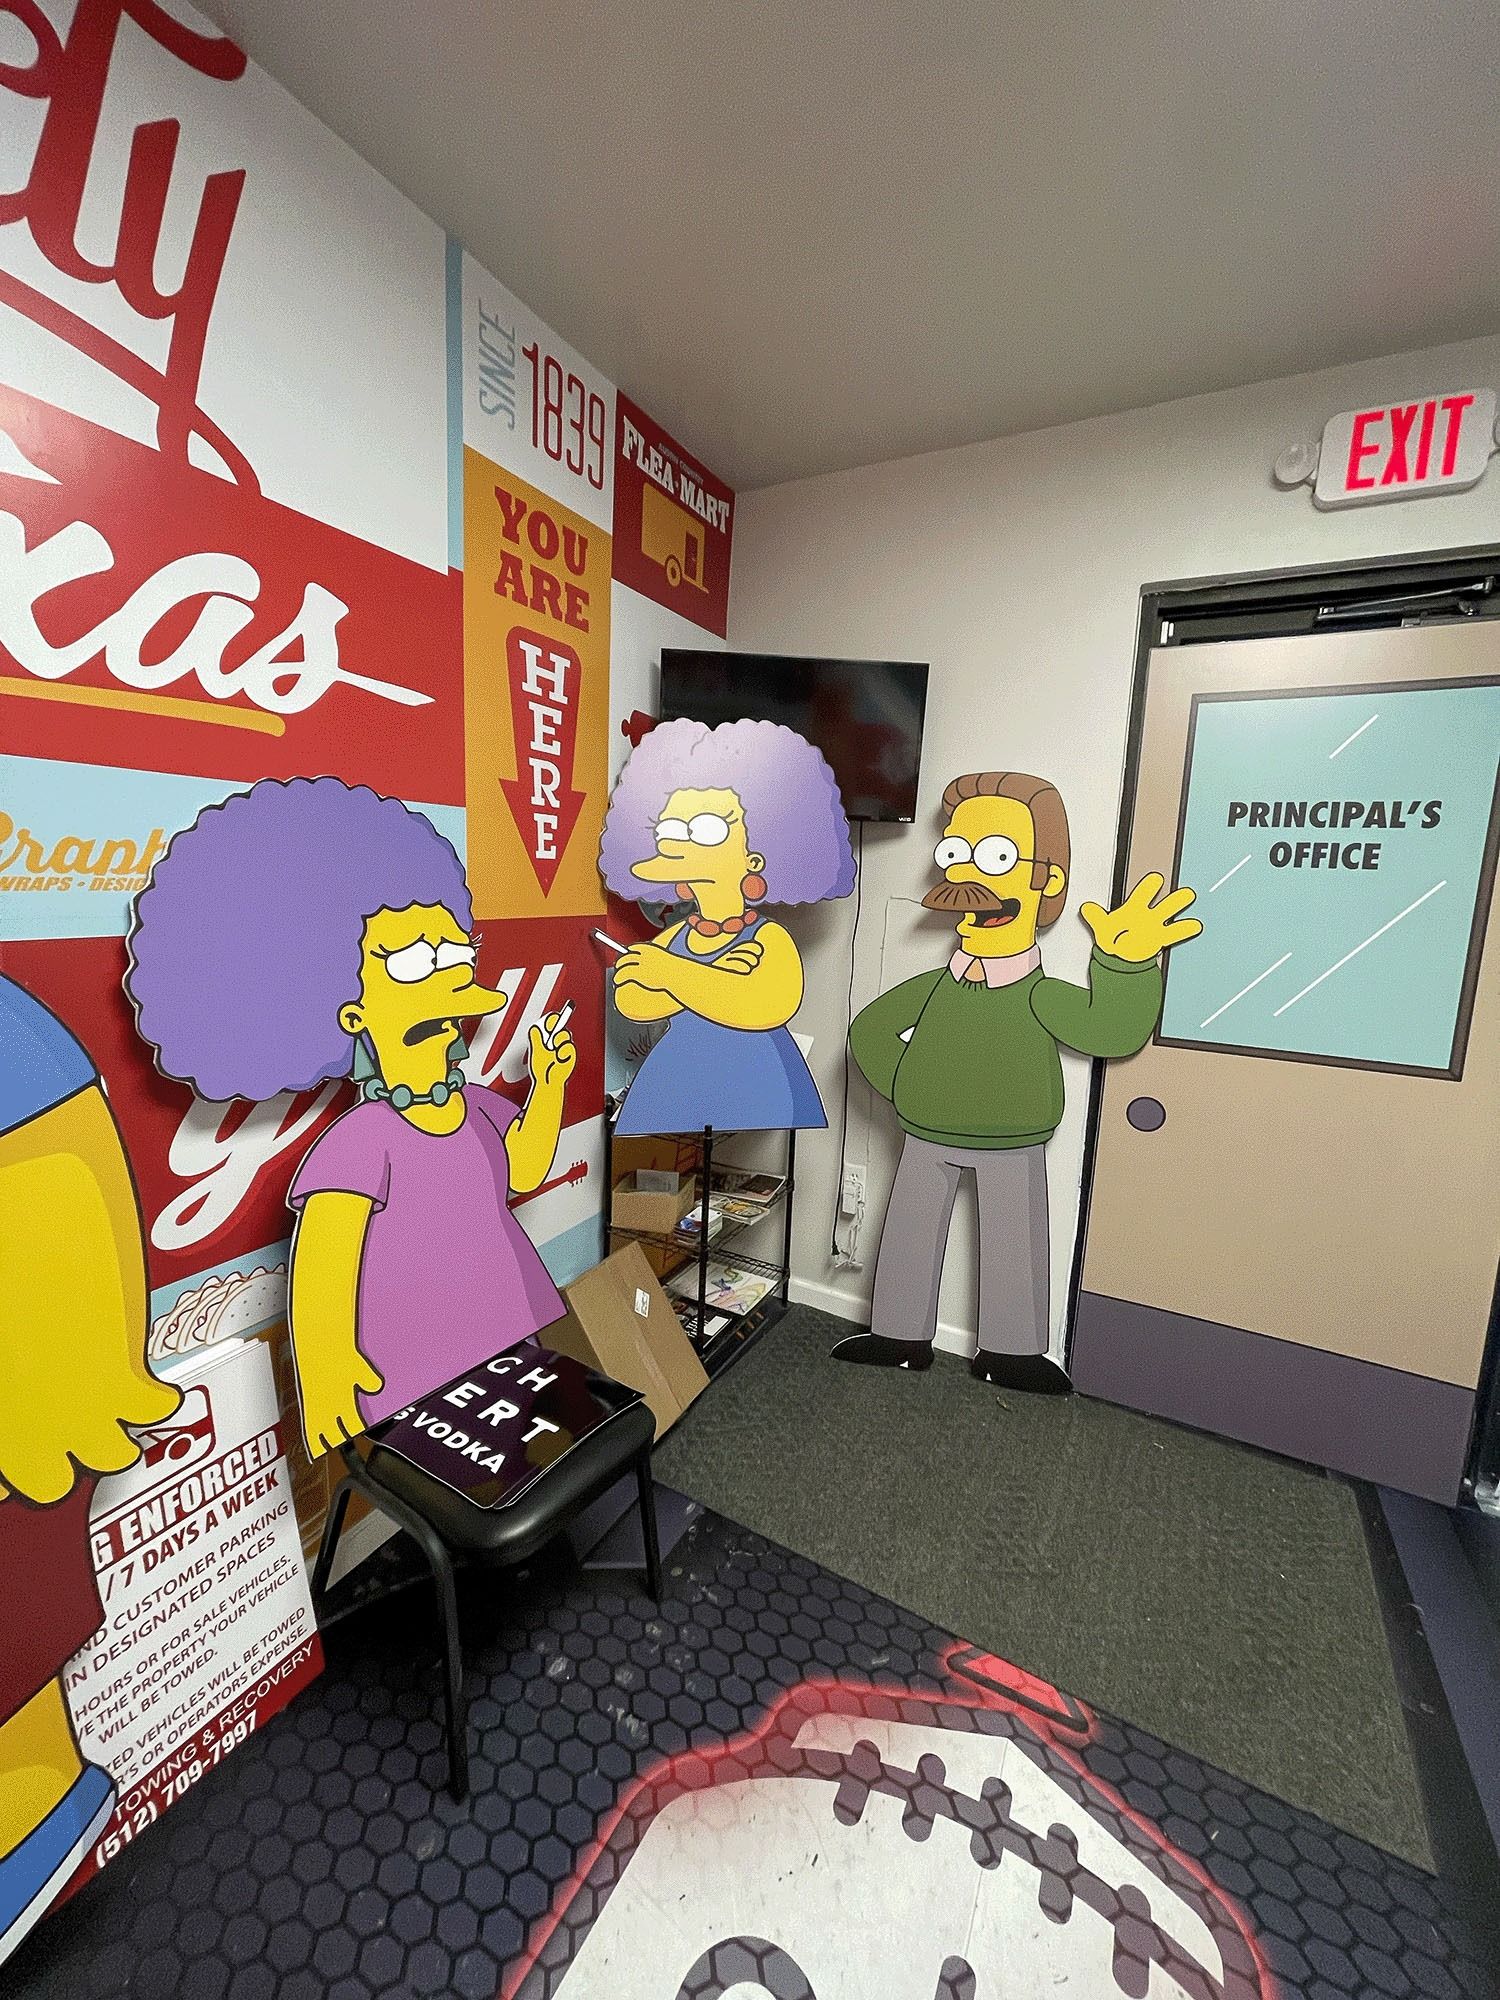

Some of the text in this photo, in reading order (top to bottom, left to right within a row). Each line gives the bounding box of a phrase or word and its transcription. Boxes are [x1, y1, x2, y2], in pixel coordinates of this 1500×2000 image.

[478, 298, 605, 490] SINCE 1839
[1345, 394, 1475, 492] EXIT
[494, 485, 589, 577] YOU
[622, 415, 675, 495] FLEA
[679, 473, 730, 534] MART
[494, 548, 590, 634] ARE
[519, 639, 572, 860] HERE
[1227, 800, 1442, 829] PRINCIPAL'S
[1269, 841, 1382, 871] OFFICE
[412, 1412, 507, 1474] VODKA
[442, 1381, 560, 1443] ERT
[120, 1430, 279, 1553] ENFORCED
[142, 1520, 200, 1574] DAYS
[205, 1509, 219, 1534] A
[223, 1468, 280, 1520] WEEK
[92, 1578, 213, 1673] DESIGNATED
[216, 1532, 276, 1583] SPACES
[113, 1551, 217, 1631] CUSTOMER
[219, 1501, 290, 1557] PARKING
[75, 1555, 291, 1722] HOURS OR FOR SALE VEHICLES.
[97, 1695, 129, 1726] THE
[132, 1634, 207, 1700] PROPERTY
[208, 1603, 248, 1638] YOUR
[248, 1562, 300, 1608] VEHICLE
[97, 1648, 219, 1744] WILL BE TOWED.
[135, 1686, 206, 1749] VEHICLES
[207, 1660, 241, 1690] WILL
[242, 1644, 259, 1664] BE
[259, 1606, 306, 1647] TOWED
[141, 1743, 165, 1767] OR
[166, 1672, 249, 1746] OPERATORS
[249, 1624, 309, 1677] EXPENSE.
[95, 1709, 259, 1869] (512) 709-7997
[114, 1640, 314, 1821] TOWING & RECOVERY
